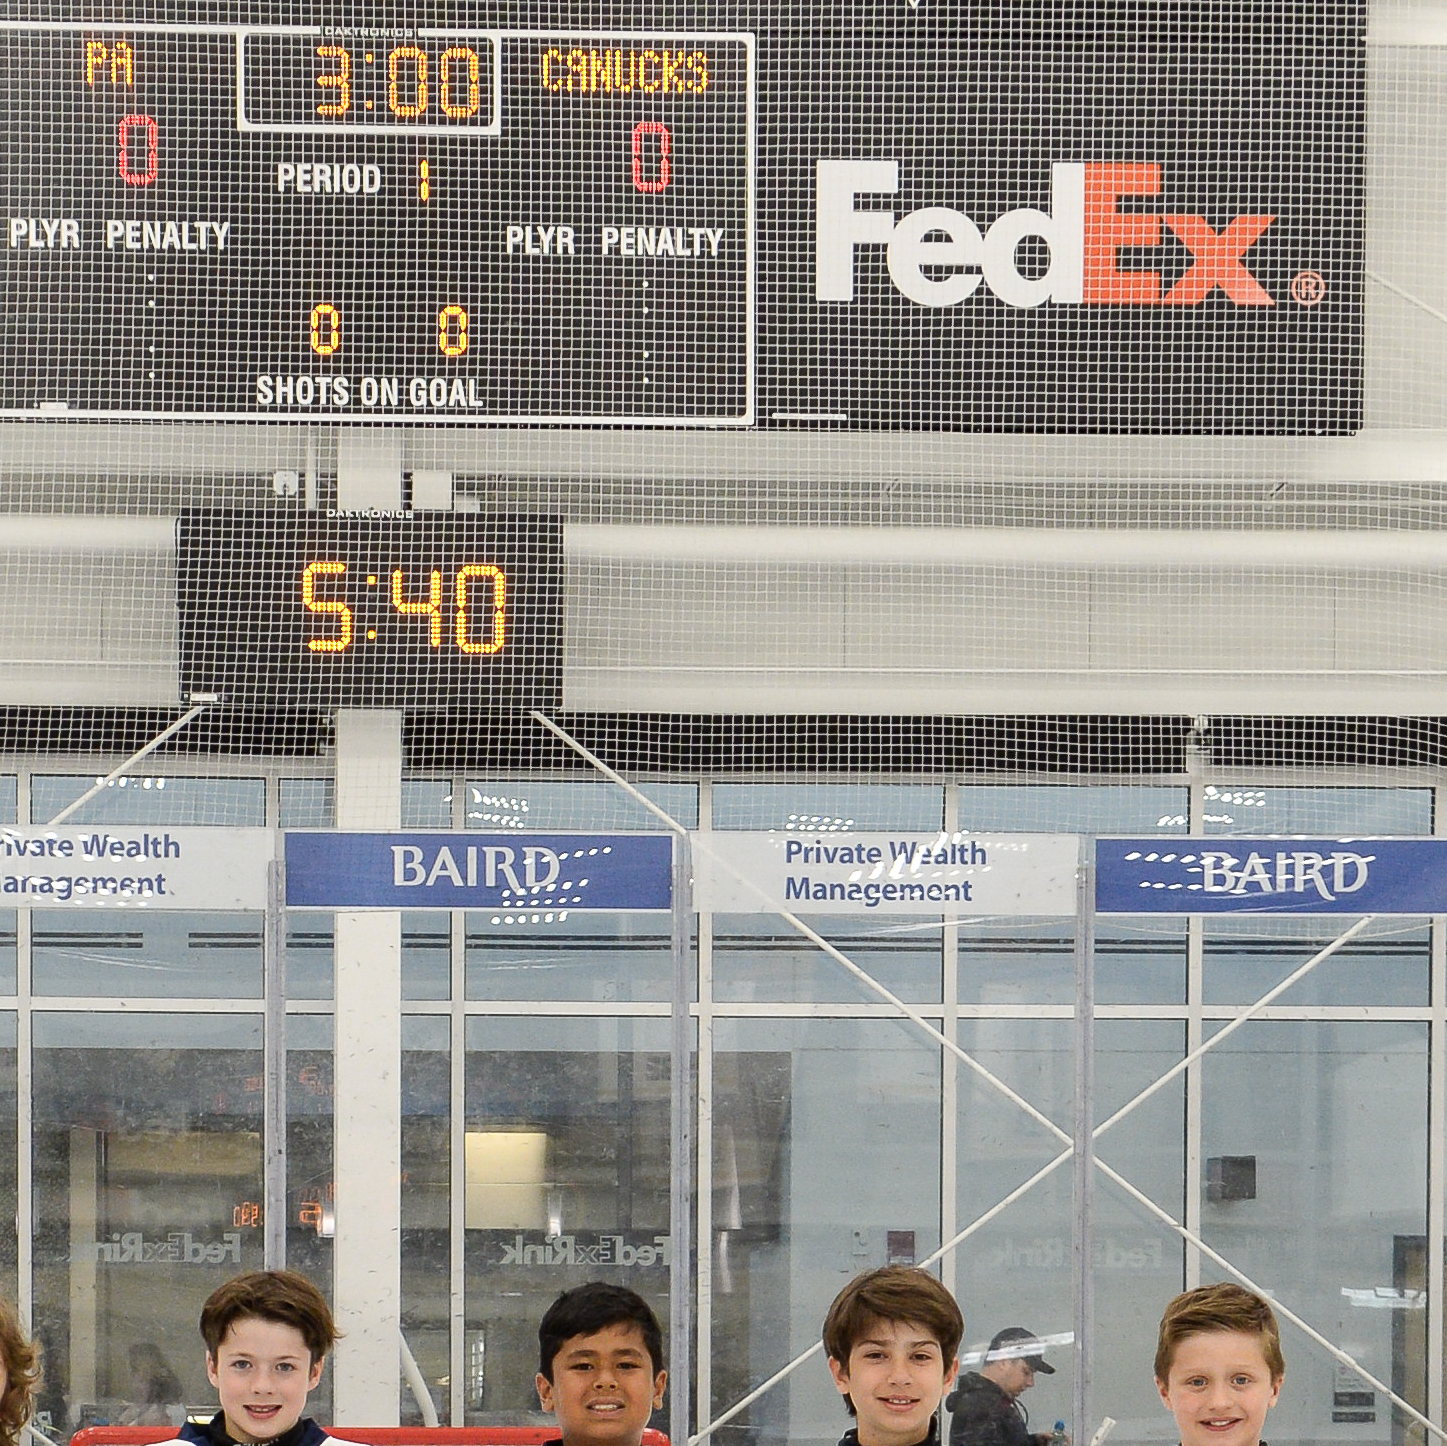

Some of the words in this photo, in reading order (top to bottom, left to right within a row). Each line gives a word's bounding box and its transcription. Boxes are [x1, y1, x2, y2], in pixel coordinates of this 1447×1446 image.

[85, 41, 134, 87] PA
[316, 45, 481, 118] 3:00
[541, 48, 710, 93] CANUCKS
[117, 114, 159, 185] 0
[630, 121, 671, 193] 0
[276, 163, 382, 196] PERIOD
[10, 219, 79, 249] PLYR
[106, 220, 230, 252] PENALTY
[506, 225, 574, 256] PLYR
[601, 227, 723, 259] PENALTY
[815, 159, 1276, 308] FedEx
[310, 303, 340, 356] 0
[439, 304, 468, 357] 0
[256, 375, 350, 406] SHOTS
[360, 377, 399, 406] ON
[409, 378, 483, 408] GOAL
[303, 561, 505, 654] 5:40
[81, 834, 181, 859] Wealth
[390, 845, 561, 896] BAIRD
[784, 840, 883, 867] Private
[888, 840, 988, 867] Wealth
[784, 877, 972, 907] Management
[1200, 850, 1370, 903] BAIRD
